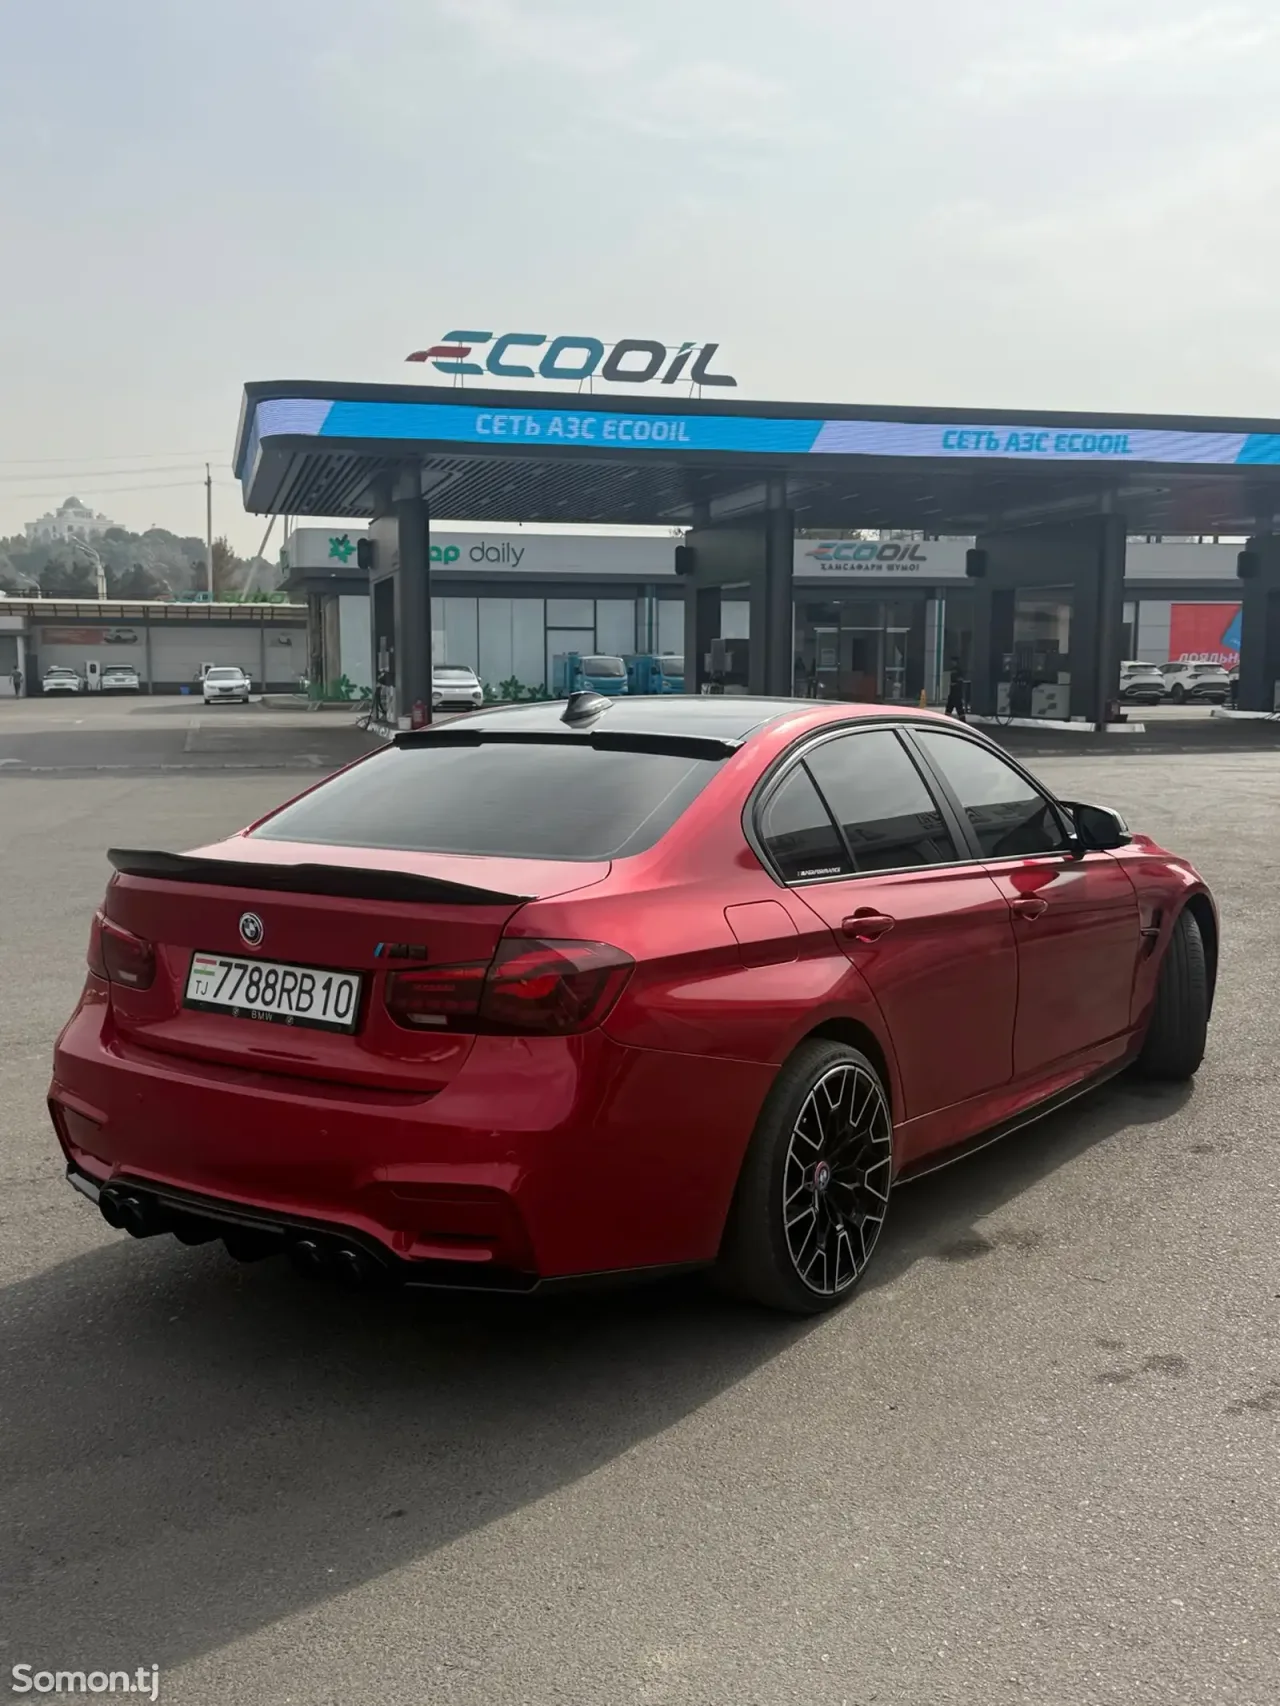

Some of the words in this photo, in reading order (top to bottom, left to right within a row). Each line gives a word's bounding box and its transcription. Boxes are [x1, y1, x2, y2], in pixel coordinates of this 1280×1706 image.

[475, 413, 541, 436] СЕТЬ
[547, 416, 597, 439] АЗС
[602, 419, 691, 441] ECOOIL
[942, 429, 1000, 451] СЕТЬ
[1005, 432, 1050, 452] АЗС
[1054, 433, 1133, 454] ECOOIL
[469, 541, 525, 567] daily
[195, 980, 209, 996] TJ
[251, 1010, 273, 1022] BMW
